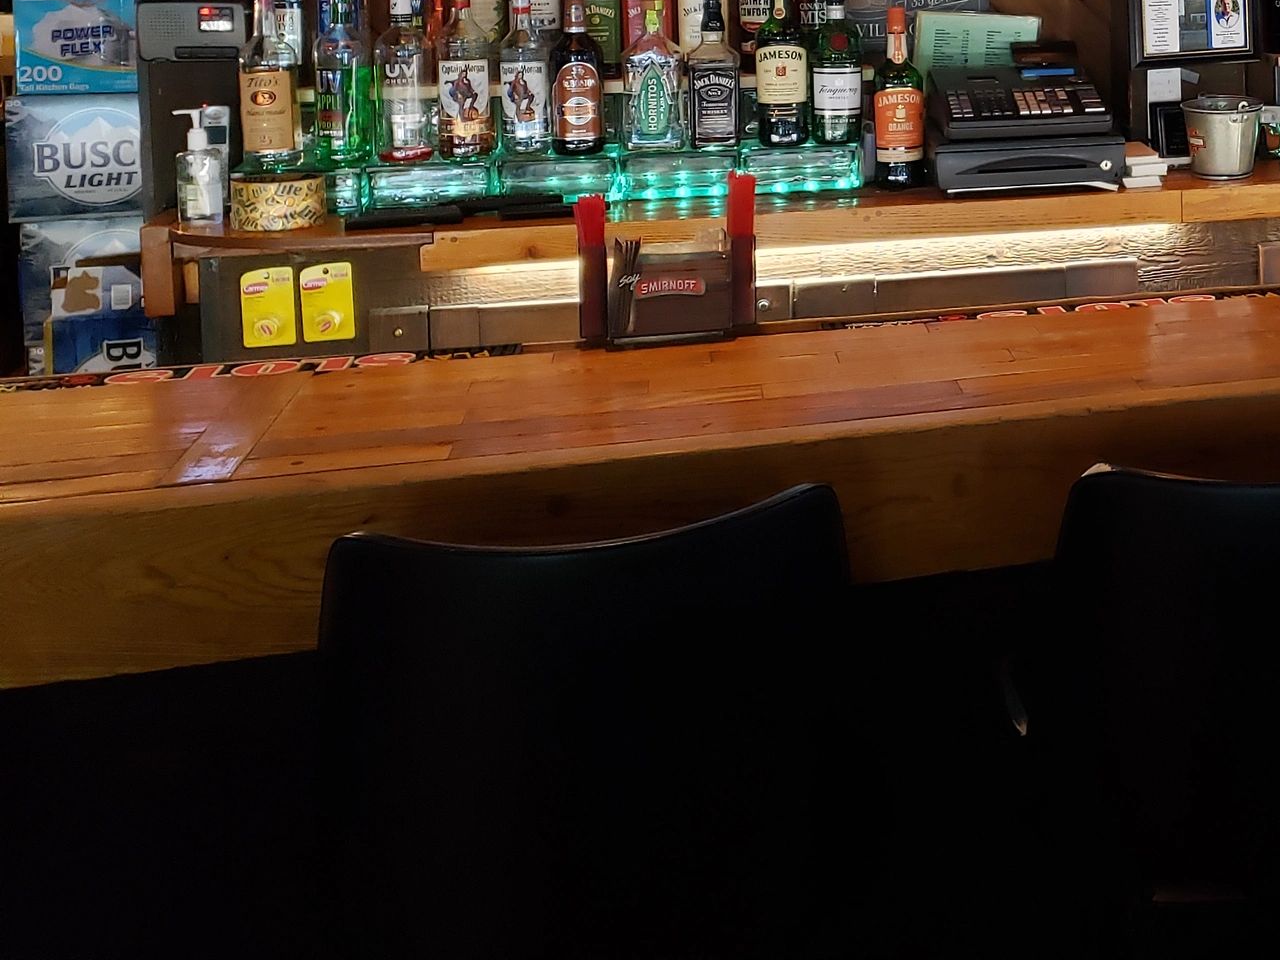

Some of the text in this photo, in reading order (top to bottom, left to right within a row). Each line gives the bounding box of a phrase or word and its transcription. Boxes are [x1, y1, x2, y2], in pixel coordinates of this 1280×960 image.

[51, 25, 115, 42] POWER
[60, 42, 104, 57] FLEX
[758, 50, 803, 62] JAMESON
[20, 66, 62, 82] 200
[385, 63, 415, 77] UV
[441, 63, 485, 75] Captain Morgan
[36, 83, 67, 91] Kitchen
[69, 83, 89, 92] Bags
[247, 76, 280, 89] Tito's
[317, 70, 341, 93] UV
[694, 74, 735, 90] JACK DANIEL'S
[648, 78, 657, 131] HORNITOS
[877, 94, 921, 107] JAMESON
[888, 122, 914, 131] ORANGE
[64, 171, 138, 189] LIGHT
[619, 273, 641, 290] say
[641, 280, 696, 294] SMIRNOFF
